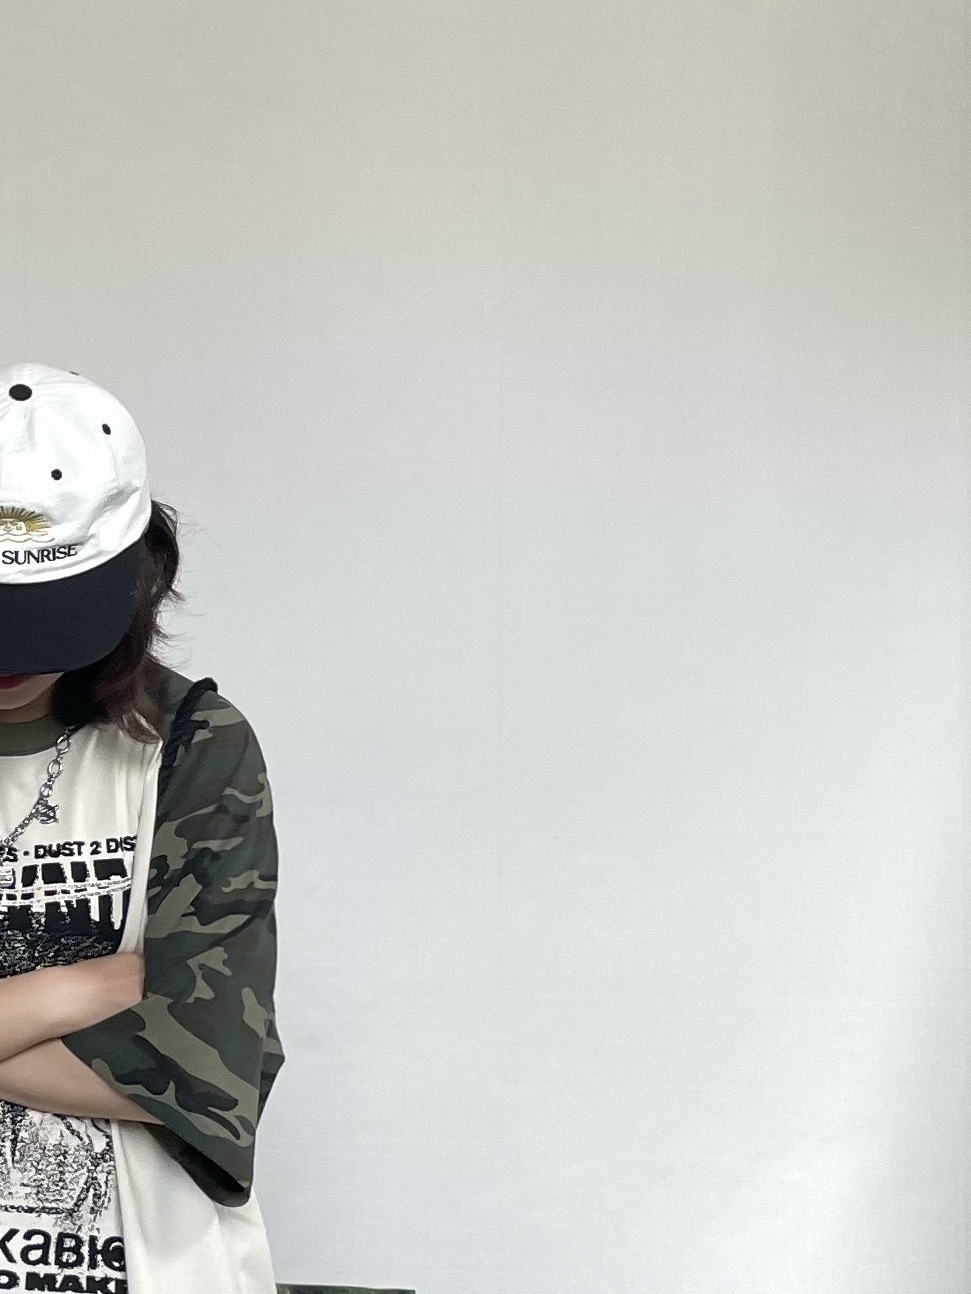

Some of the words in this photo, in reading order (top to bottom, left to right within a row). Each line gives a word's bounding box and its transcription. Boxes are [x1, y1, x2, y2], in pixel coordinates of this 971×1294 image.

[1, 543, 78, 565] SUNRISE
[34, 840, 85, 859] DUST
[89, 840, 102, 856] 2
